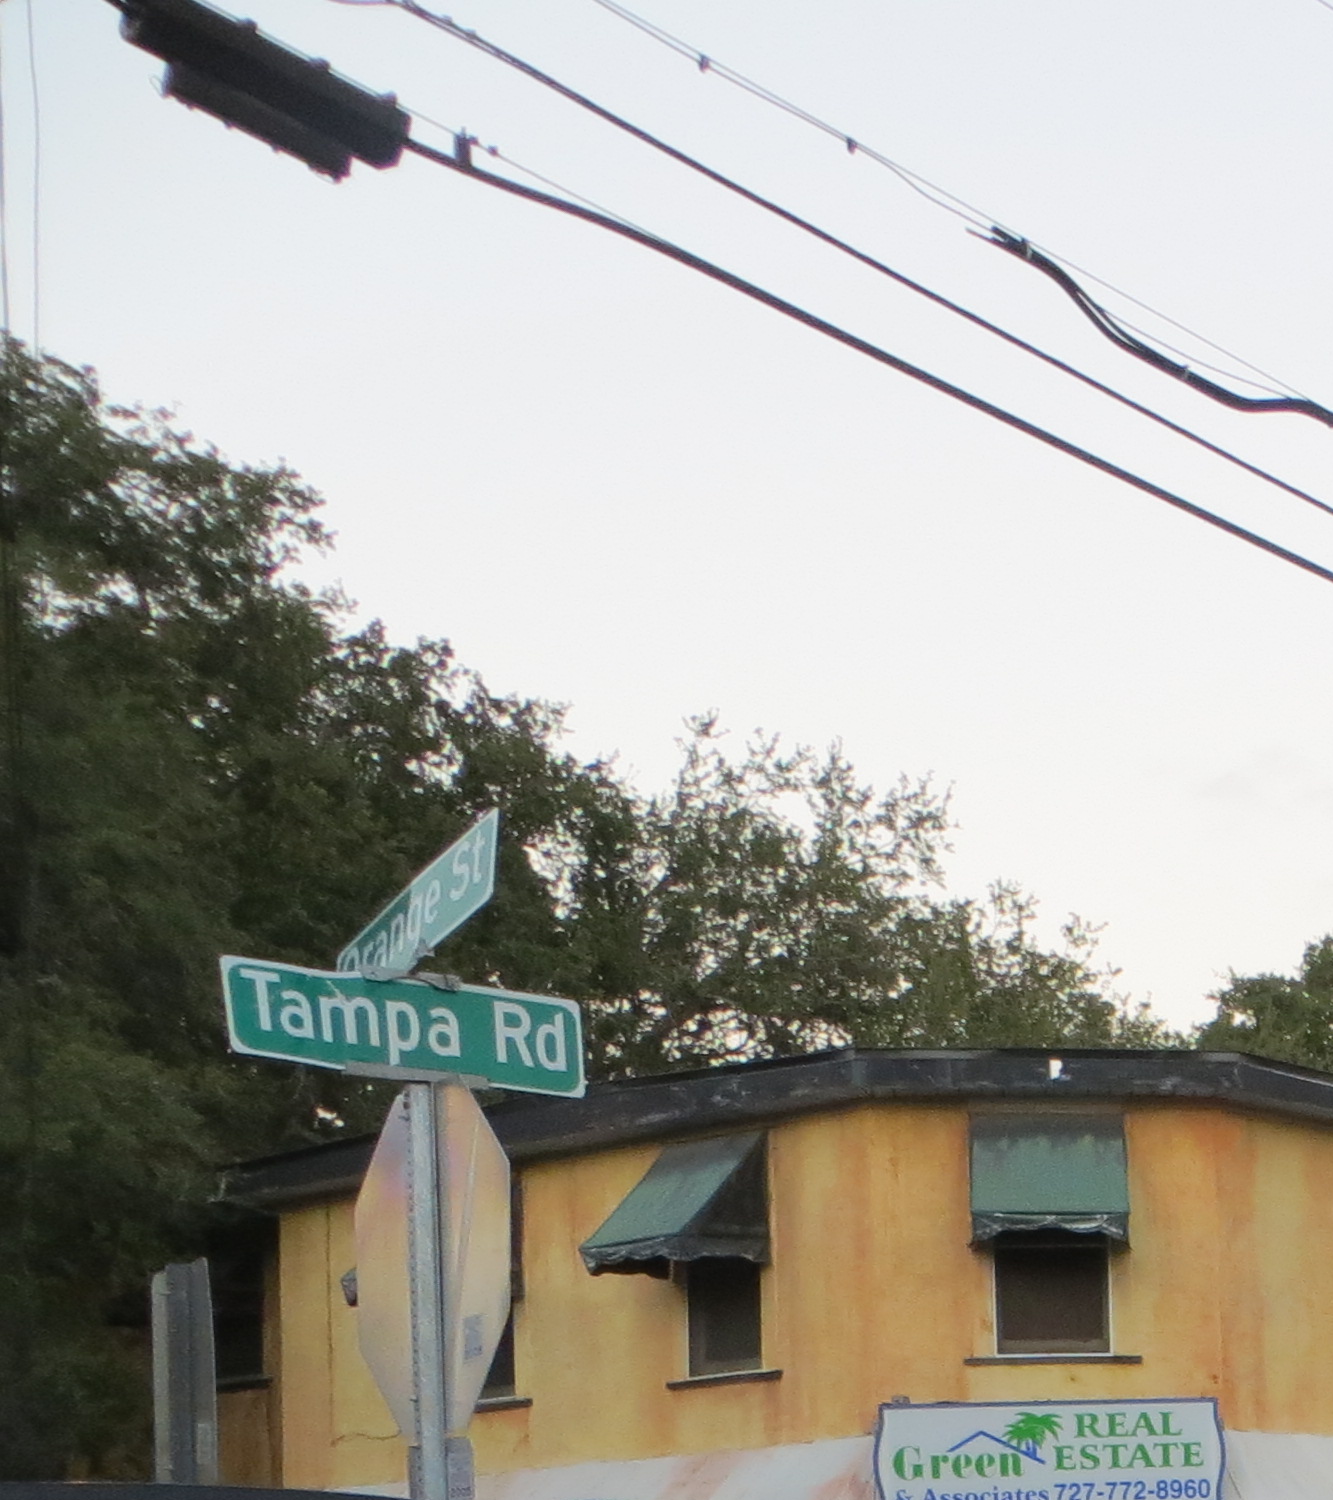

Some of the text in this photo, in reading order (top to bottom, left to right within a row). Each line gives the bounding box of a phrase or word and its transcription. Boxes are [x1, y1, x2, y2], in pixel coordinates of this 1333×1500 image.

[449, 829, 485, 901] St
[239, 968, 568, 1073] Tampa Rd
[1074, 1411, 1183, 1438] REAL
[891, 1446, 1025, 1481] Green
[1052, 1441, 1205, 1471] ESTATE
